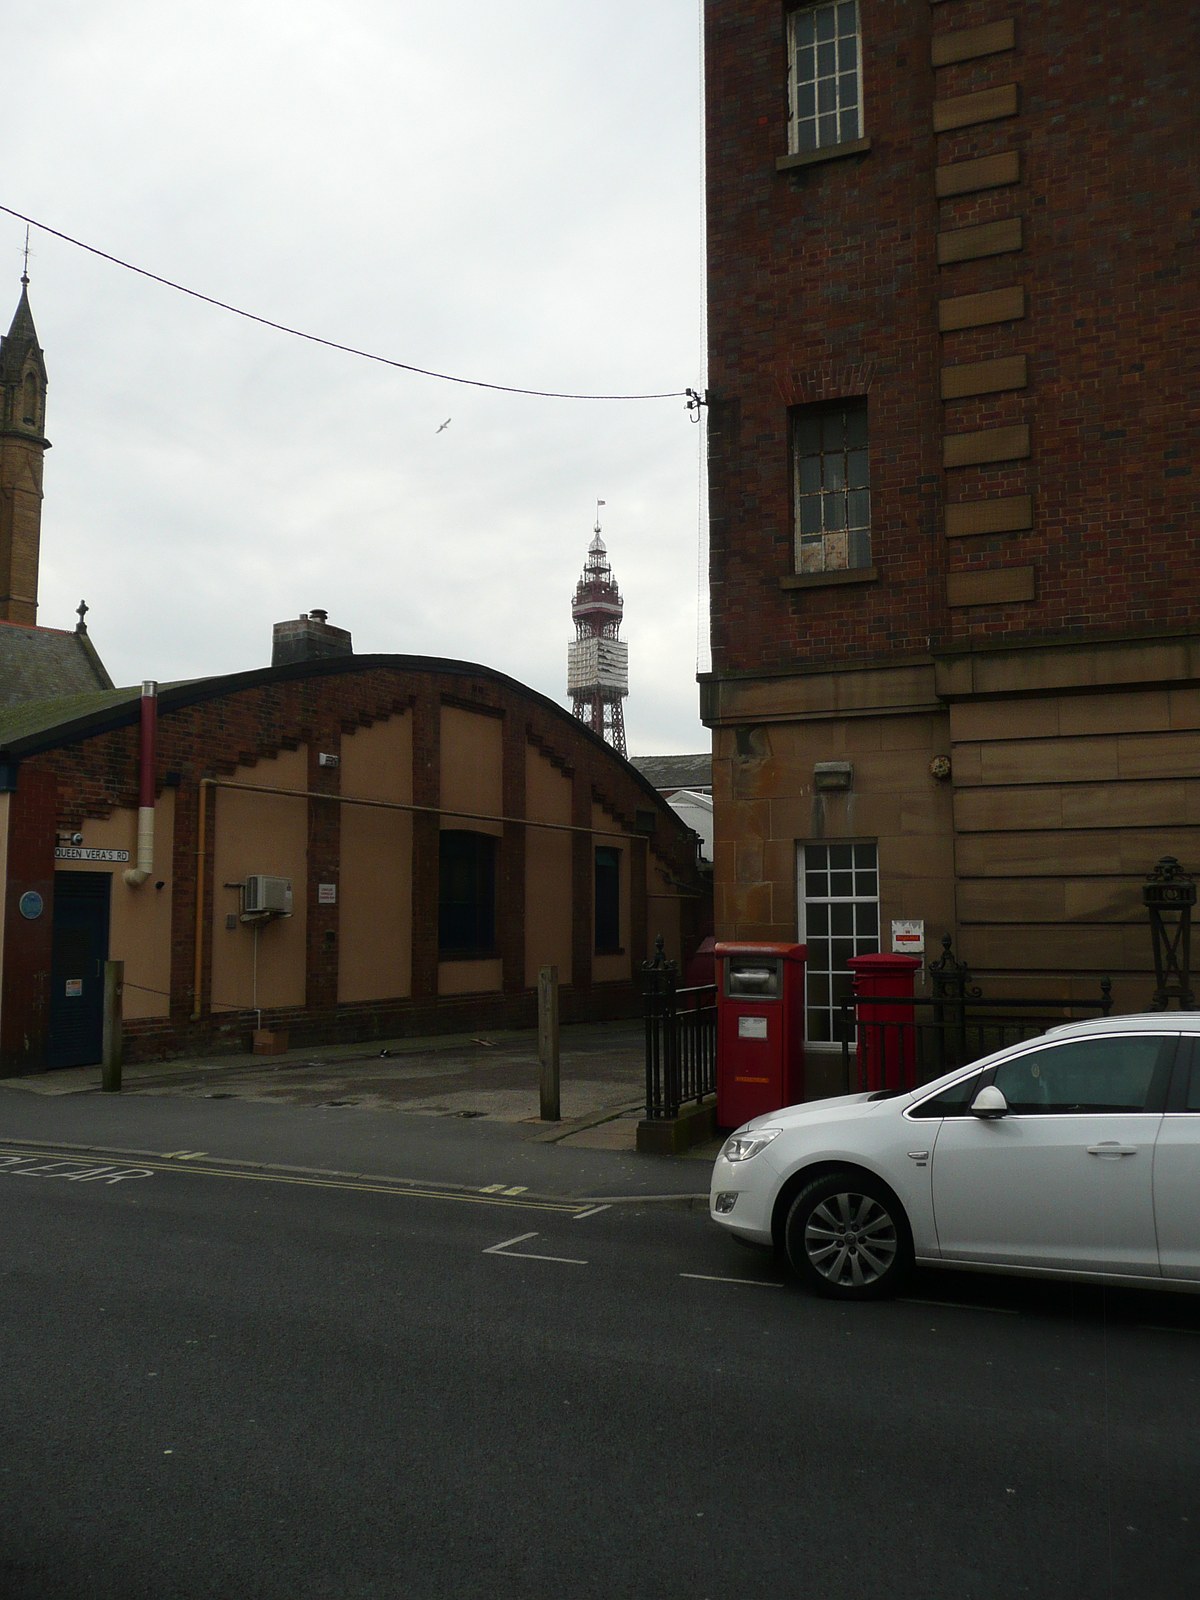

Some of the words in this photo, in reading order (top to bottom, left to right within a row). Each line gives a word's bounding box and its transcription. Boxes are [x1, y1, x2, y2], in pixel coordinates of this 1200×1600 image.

[55, 848, 82, 858] QUEEN
[86, 850, 113, 860] VERA'S
[116, 851, 127, 861] RD
